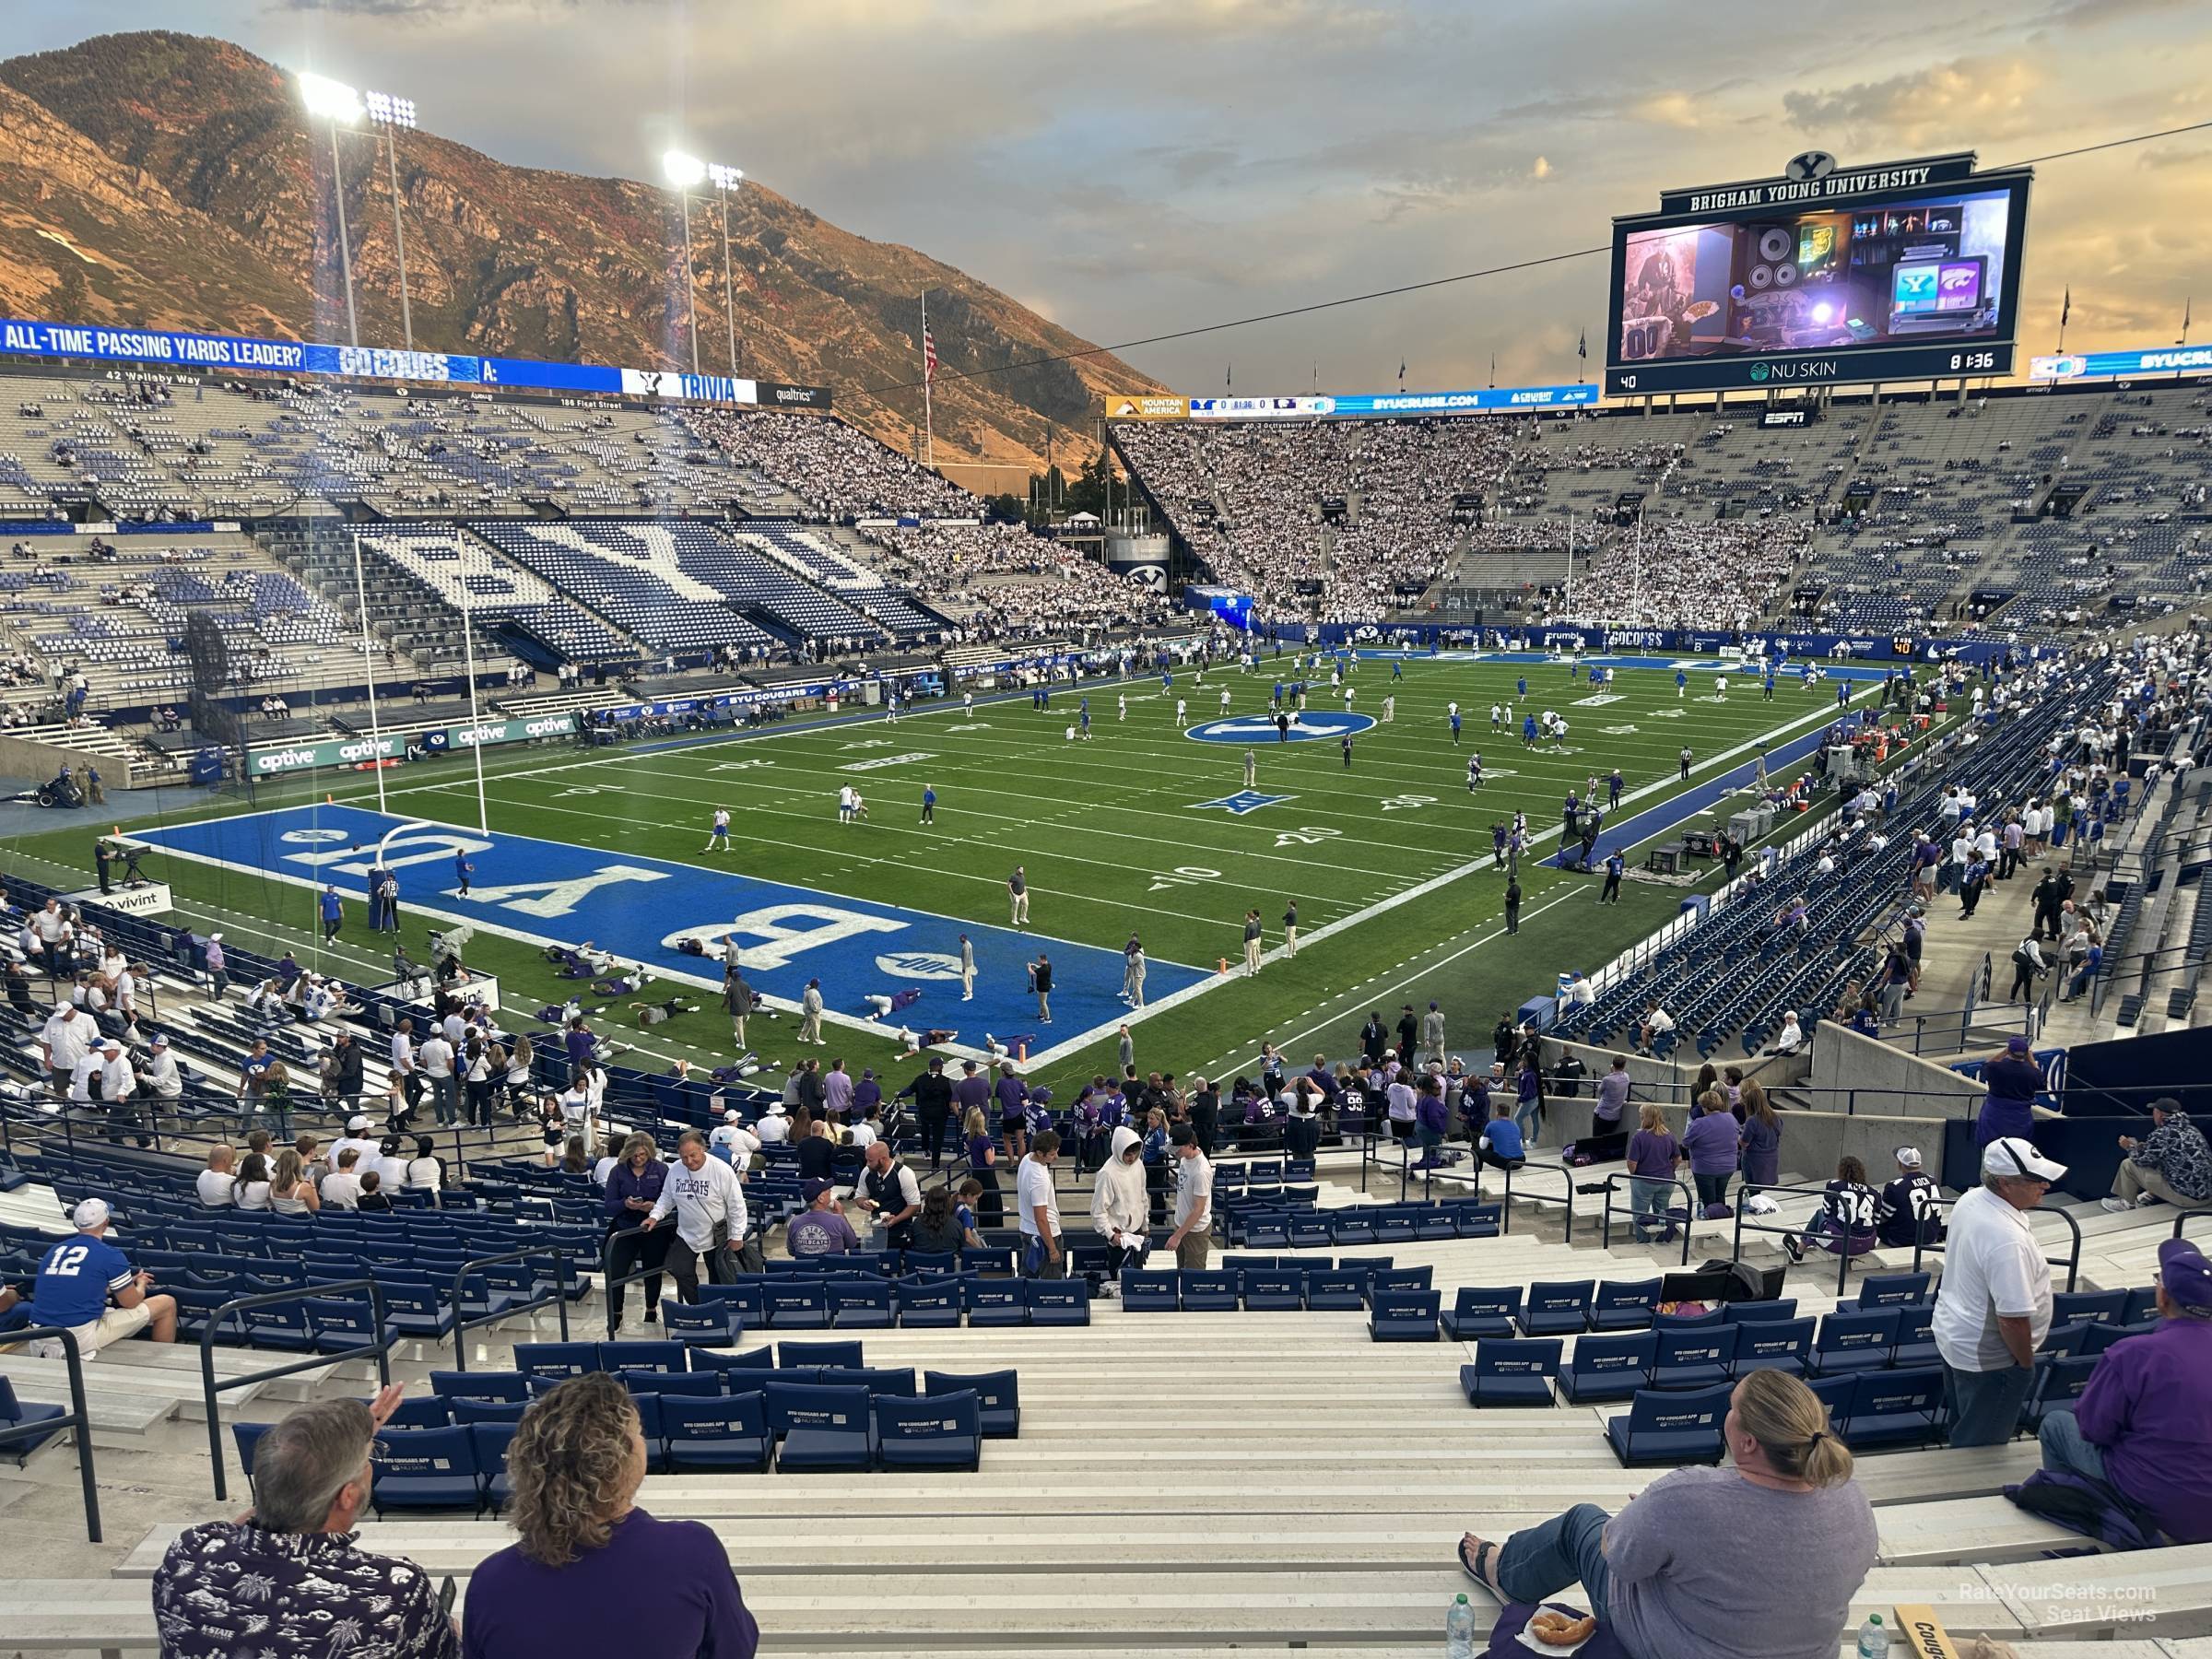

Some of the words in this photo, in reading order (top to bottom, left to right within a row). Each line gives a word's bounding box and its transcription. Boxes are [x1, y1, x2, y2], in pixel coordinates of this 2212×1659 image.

[1793, 154, 1826, 179] Y
[1690, 189, 1761, 212] BRIGHAM
[1769, 182, 1819, 202] YOUNG
[1826, 168, 1930, 195] UNIVERSITY
[6, 325, 94, 353] ALL-TIME
[98, 332, 171, 359] PASSING
[174, 337, 230, 362] YARDS
[233, 342, 302, 367] LEADER?
[106, 371, 121, 380] 42
[125, 371, 172, 384] Wallaby
[177, 373, 200, 386] Way
[483, 360, 498, 382] A:
[1771, 363, 1795, 379] NU
[1800, 361, 1836, 377] SKIN
[678, 373, 735, 402] TRIVIA
[1620, 376, 1637, 388] 40
[776, 387, 811, 403] qualtrics
[1141, 398, 1182, 407] MOUNTAIN
[1373, 394, 1478, 410] BYUCRUISE.COM
[599, 401, 622, 409] Street
[1144, 406, 1181, 415] AMERICA
[1764, 412, 1805, 424] ESPN
[1896, 643, 1911, 654] 40
[729, 696, 752, 704] BYU
[754, 688, 807, 701] COUGARS
[458, 724, 505, 746] aptive
[525, 718, 570, 736] aptive
[339, 739, 392, 761] aptive
[258, 749, 315, 771] aptive
[1276, 827, 1343, 844] 20
[1151, 866, 1222, 886] 10
[118, 892, 158, 911] vivint
[676, 1184, 709, 1196] WILDCATS
[1912, 1177, 1931, 1188] KOCH
[45, 1245, 89, 1277] 12
